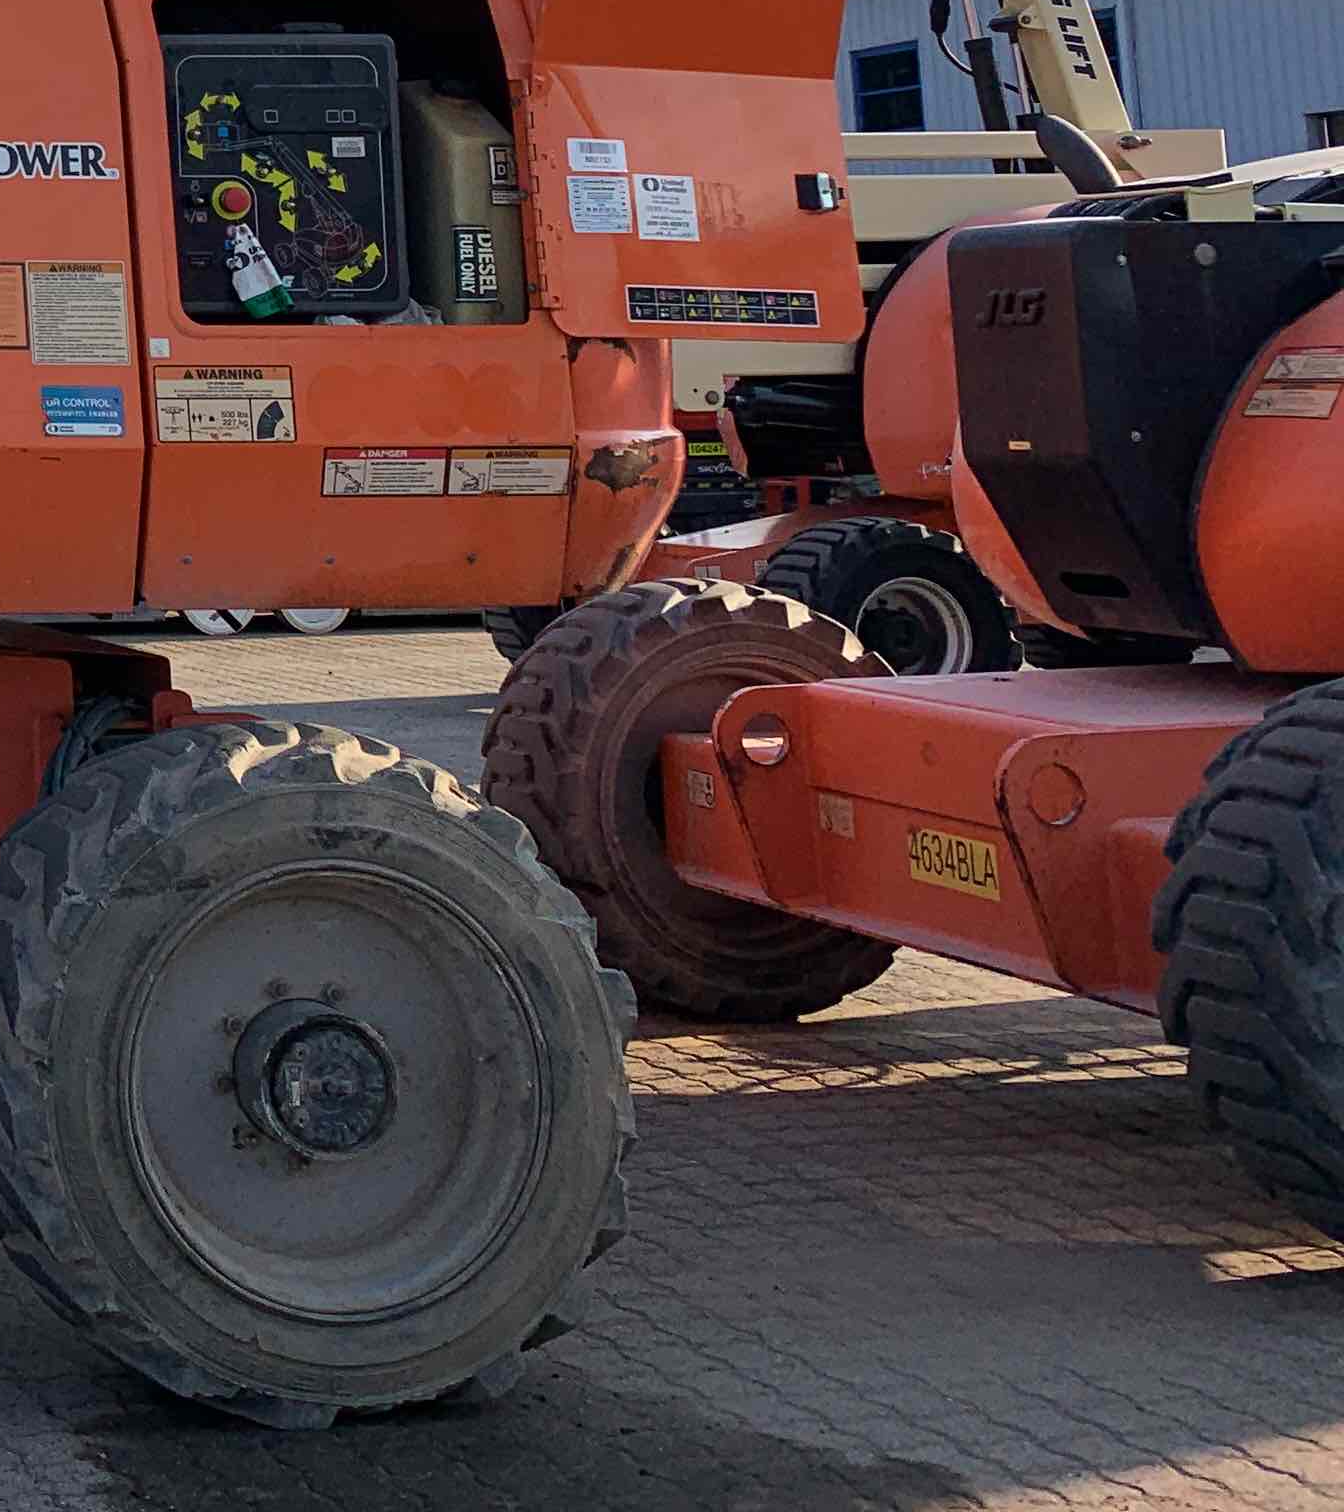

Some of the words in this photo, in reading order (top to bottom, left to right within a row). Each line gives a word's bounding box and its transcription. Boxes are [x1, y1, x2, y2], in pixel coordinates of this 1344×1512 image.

[1058, 17, 1097, 80] LIFT
[459, 234, 473, 259] FUEL
[477, 233, 497, 294] DIESEL
[460, 263, 475, 294] ONLY
[196, 369, 264, 380] WARNING
[62, 398, 112, 408] CONTROL
[368, 450, 409, 458] DANGER
[909, 831, 998, 889] 4634BLA
